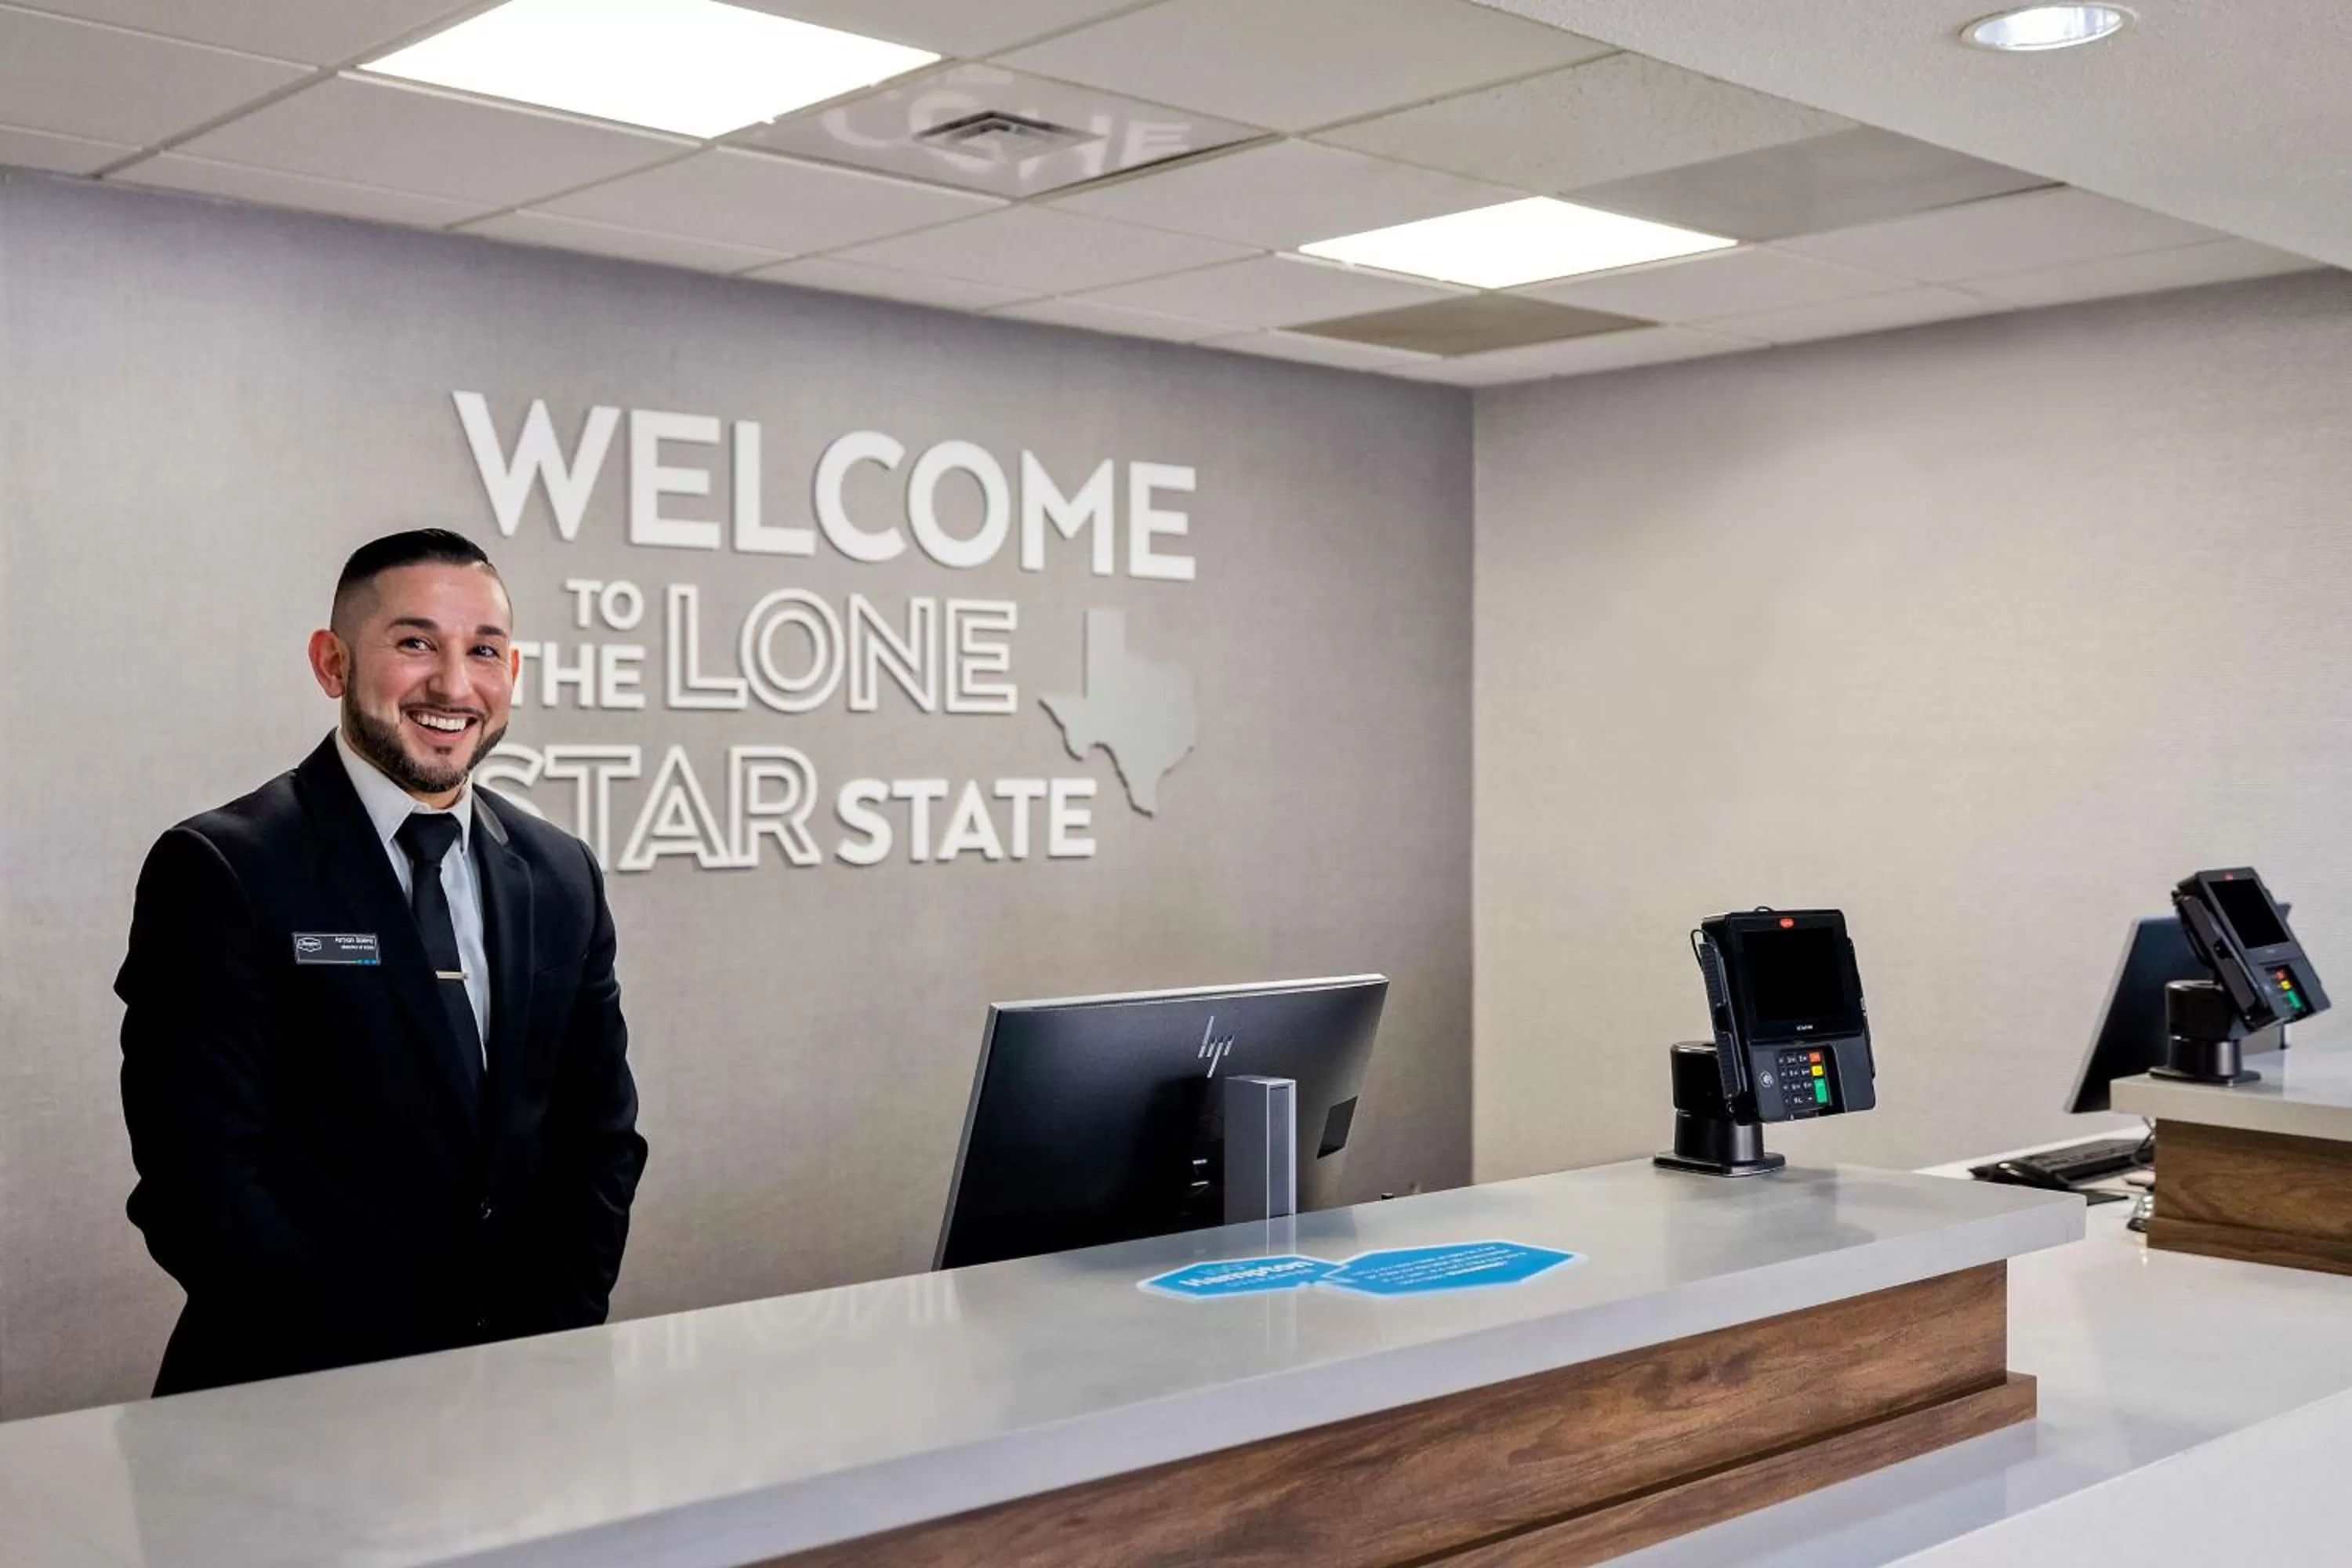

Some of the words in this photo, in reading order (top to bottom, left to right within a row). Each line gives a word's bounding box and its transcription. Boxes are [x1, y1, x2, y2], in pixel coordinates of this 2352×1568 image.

[453, 391, 1196, 580] WELCOME
[564, 579, 644, 630] TO
[511, 641, 645, 708] THE
[669, 583, 1018, 713] LONE
[837, 778, 1097, 864] STATE
[1198, 1015, 1235, 1079] hp
